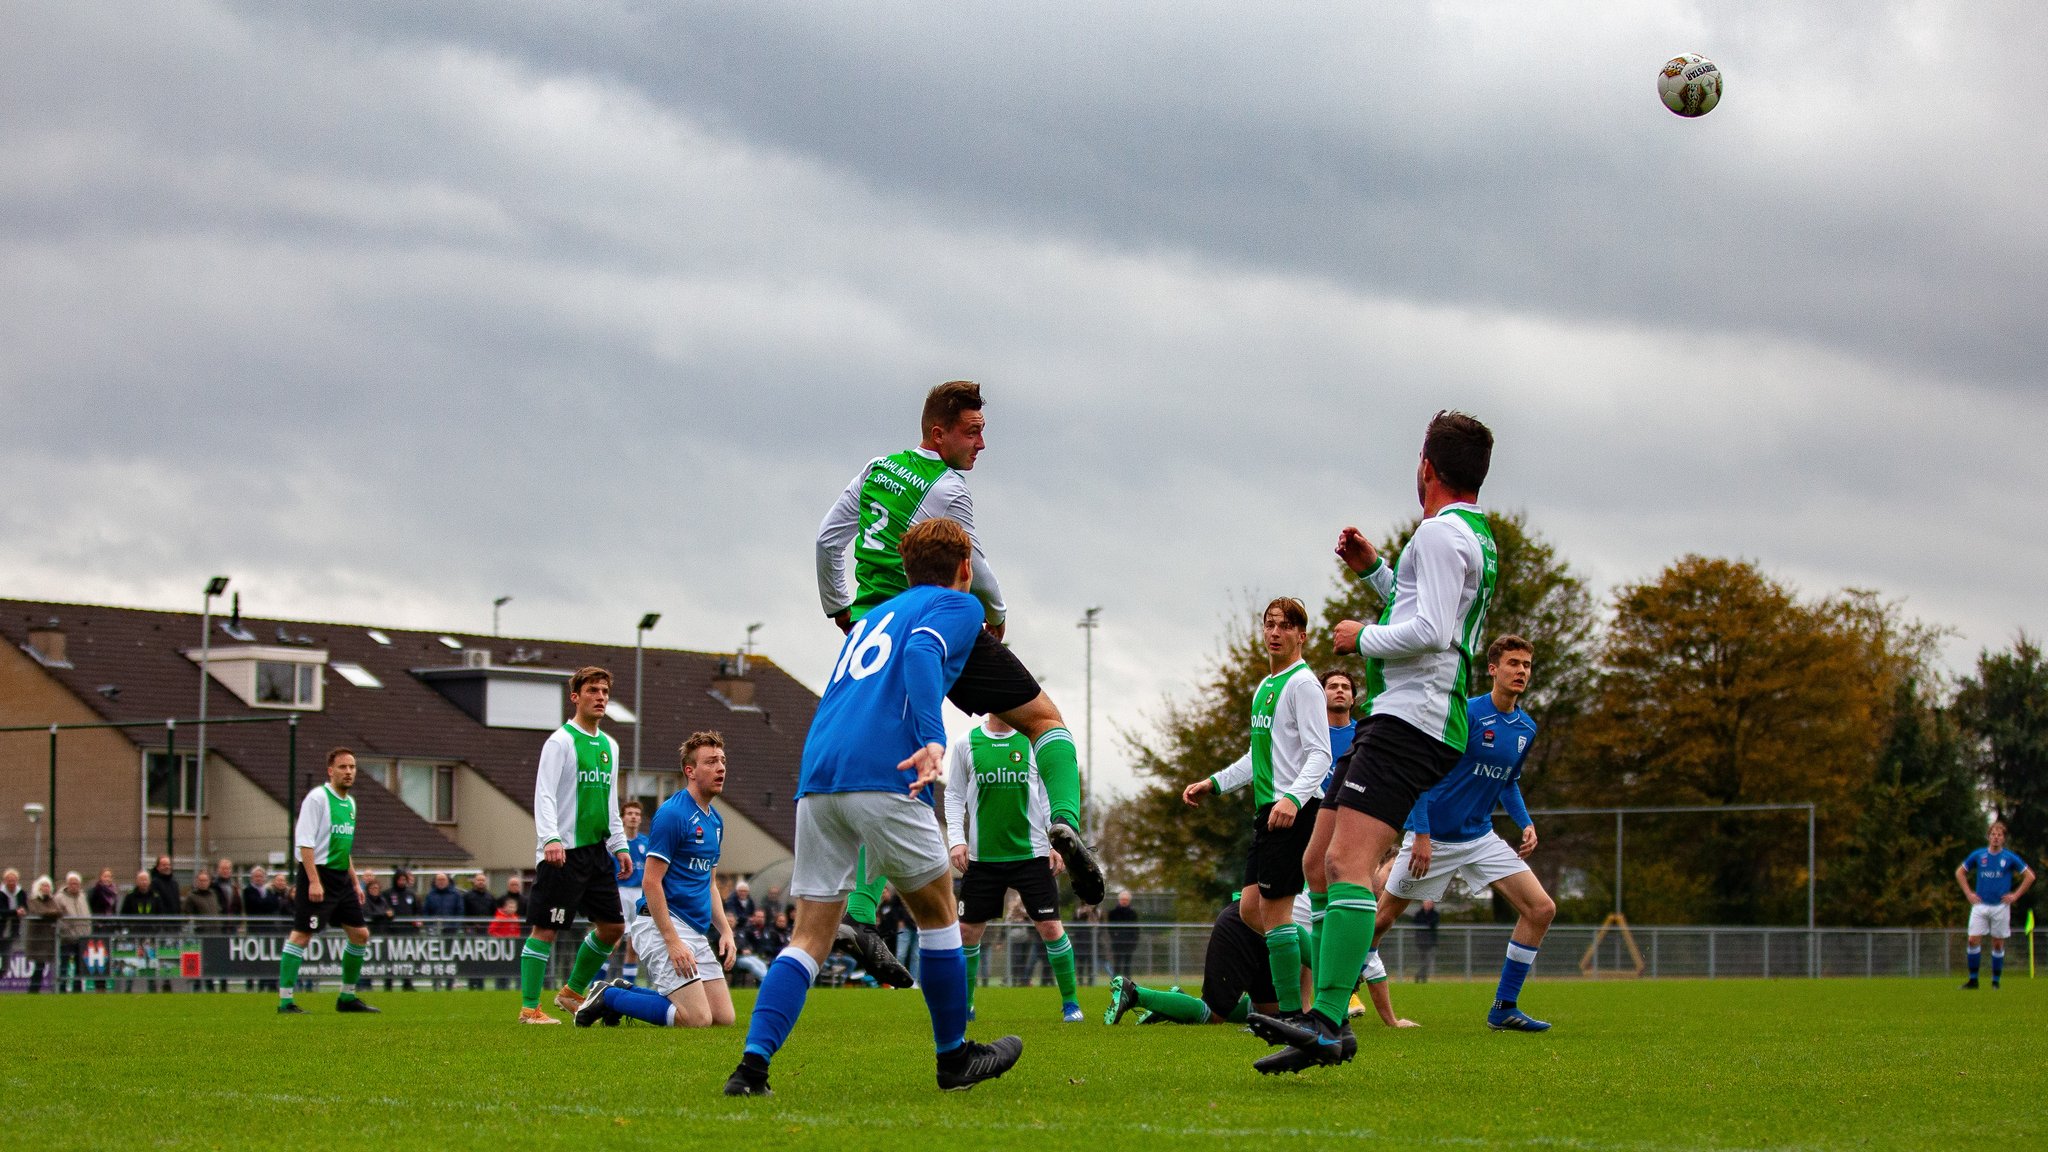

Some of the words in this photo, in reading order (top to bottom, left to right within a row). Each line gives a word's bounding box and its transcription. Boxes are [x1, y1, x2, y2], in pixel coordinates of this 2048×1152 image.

[874, 473, 907, 496] SPORT
[877, 457, 929, 492] BAHLMANN
[862, 501, 889, 550] 2
[833, 611, 895, 684] 16
[1473, 763, 1503, 779] ING
[688, 857, 711, 872] ING
[550, 907, 565, 924] 14
[958, 901, 964, 916] 8
[309, 916, 318, 929] 3
[229, 938, 324, 961] HOLLD
[327, 938, 384, 961] WST
[387, 938, 516, 961] MAKELAARDIJ
